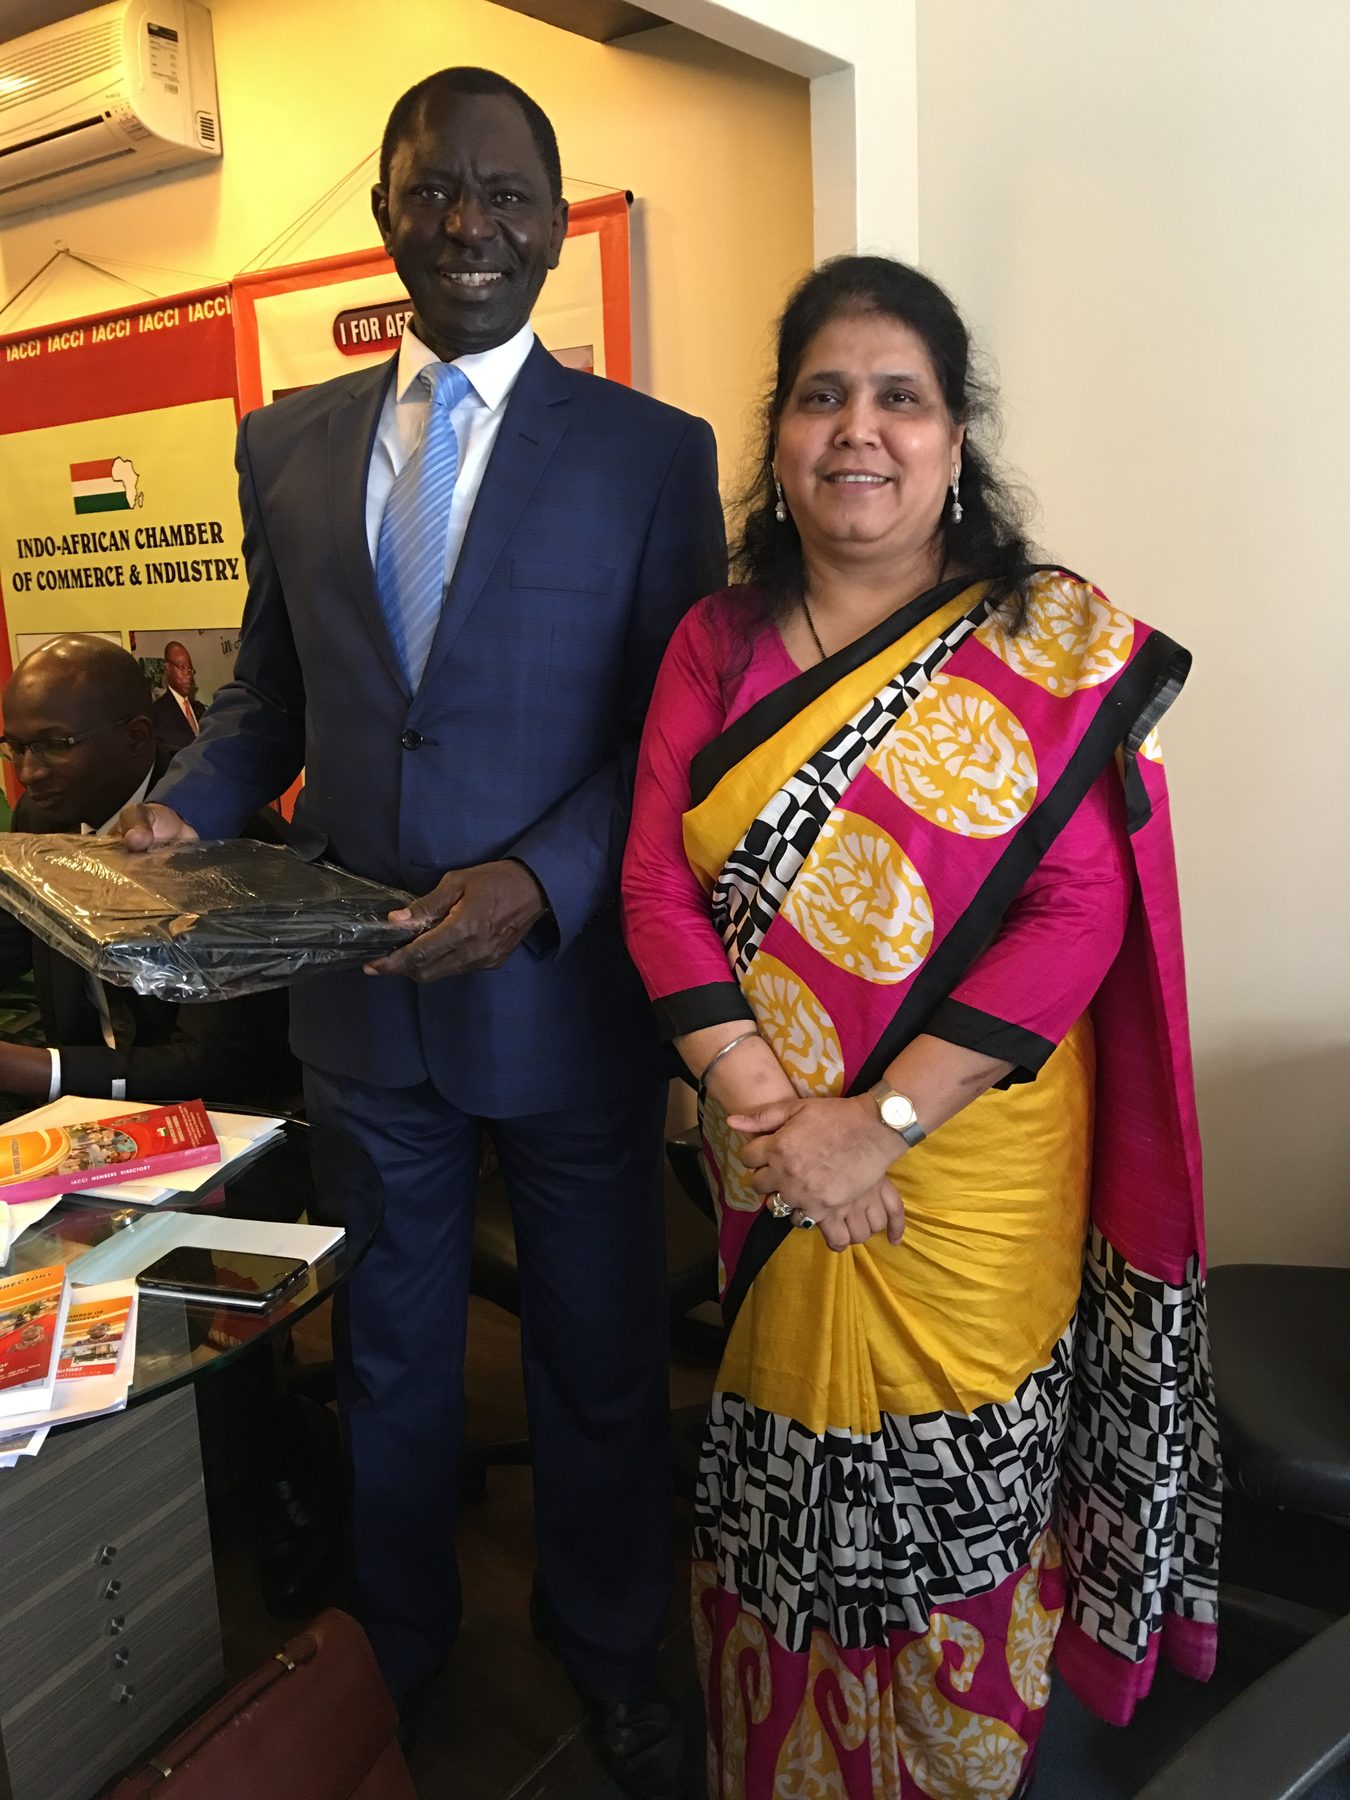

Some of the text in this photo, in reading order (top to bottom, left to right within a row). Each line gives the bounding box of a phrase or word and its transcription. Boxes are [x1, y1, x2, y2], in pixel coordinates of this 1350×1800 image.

[6, 294, 232, 362] IACCI IACCI IACCI IACCI IACCI
[339, 322, 347, 345] I
[350, 317, 382, 343] FOR
[16, 521, 225, 559] INDO-AFRICAN CHAMBER
[12, 557, 239, 592] OF COMMERCE & INDUSTRY
[120, 1165, 151, 1175] DIRECTORY
